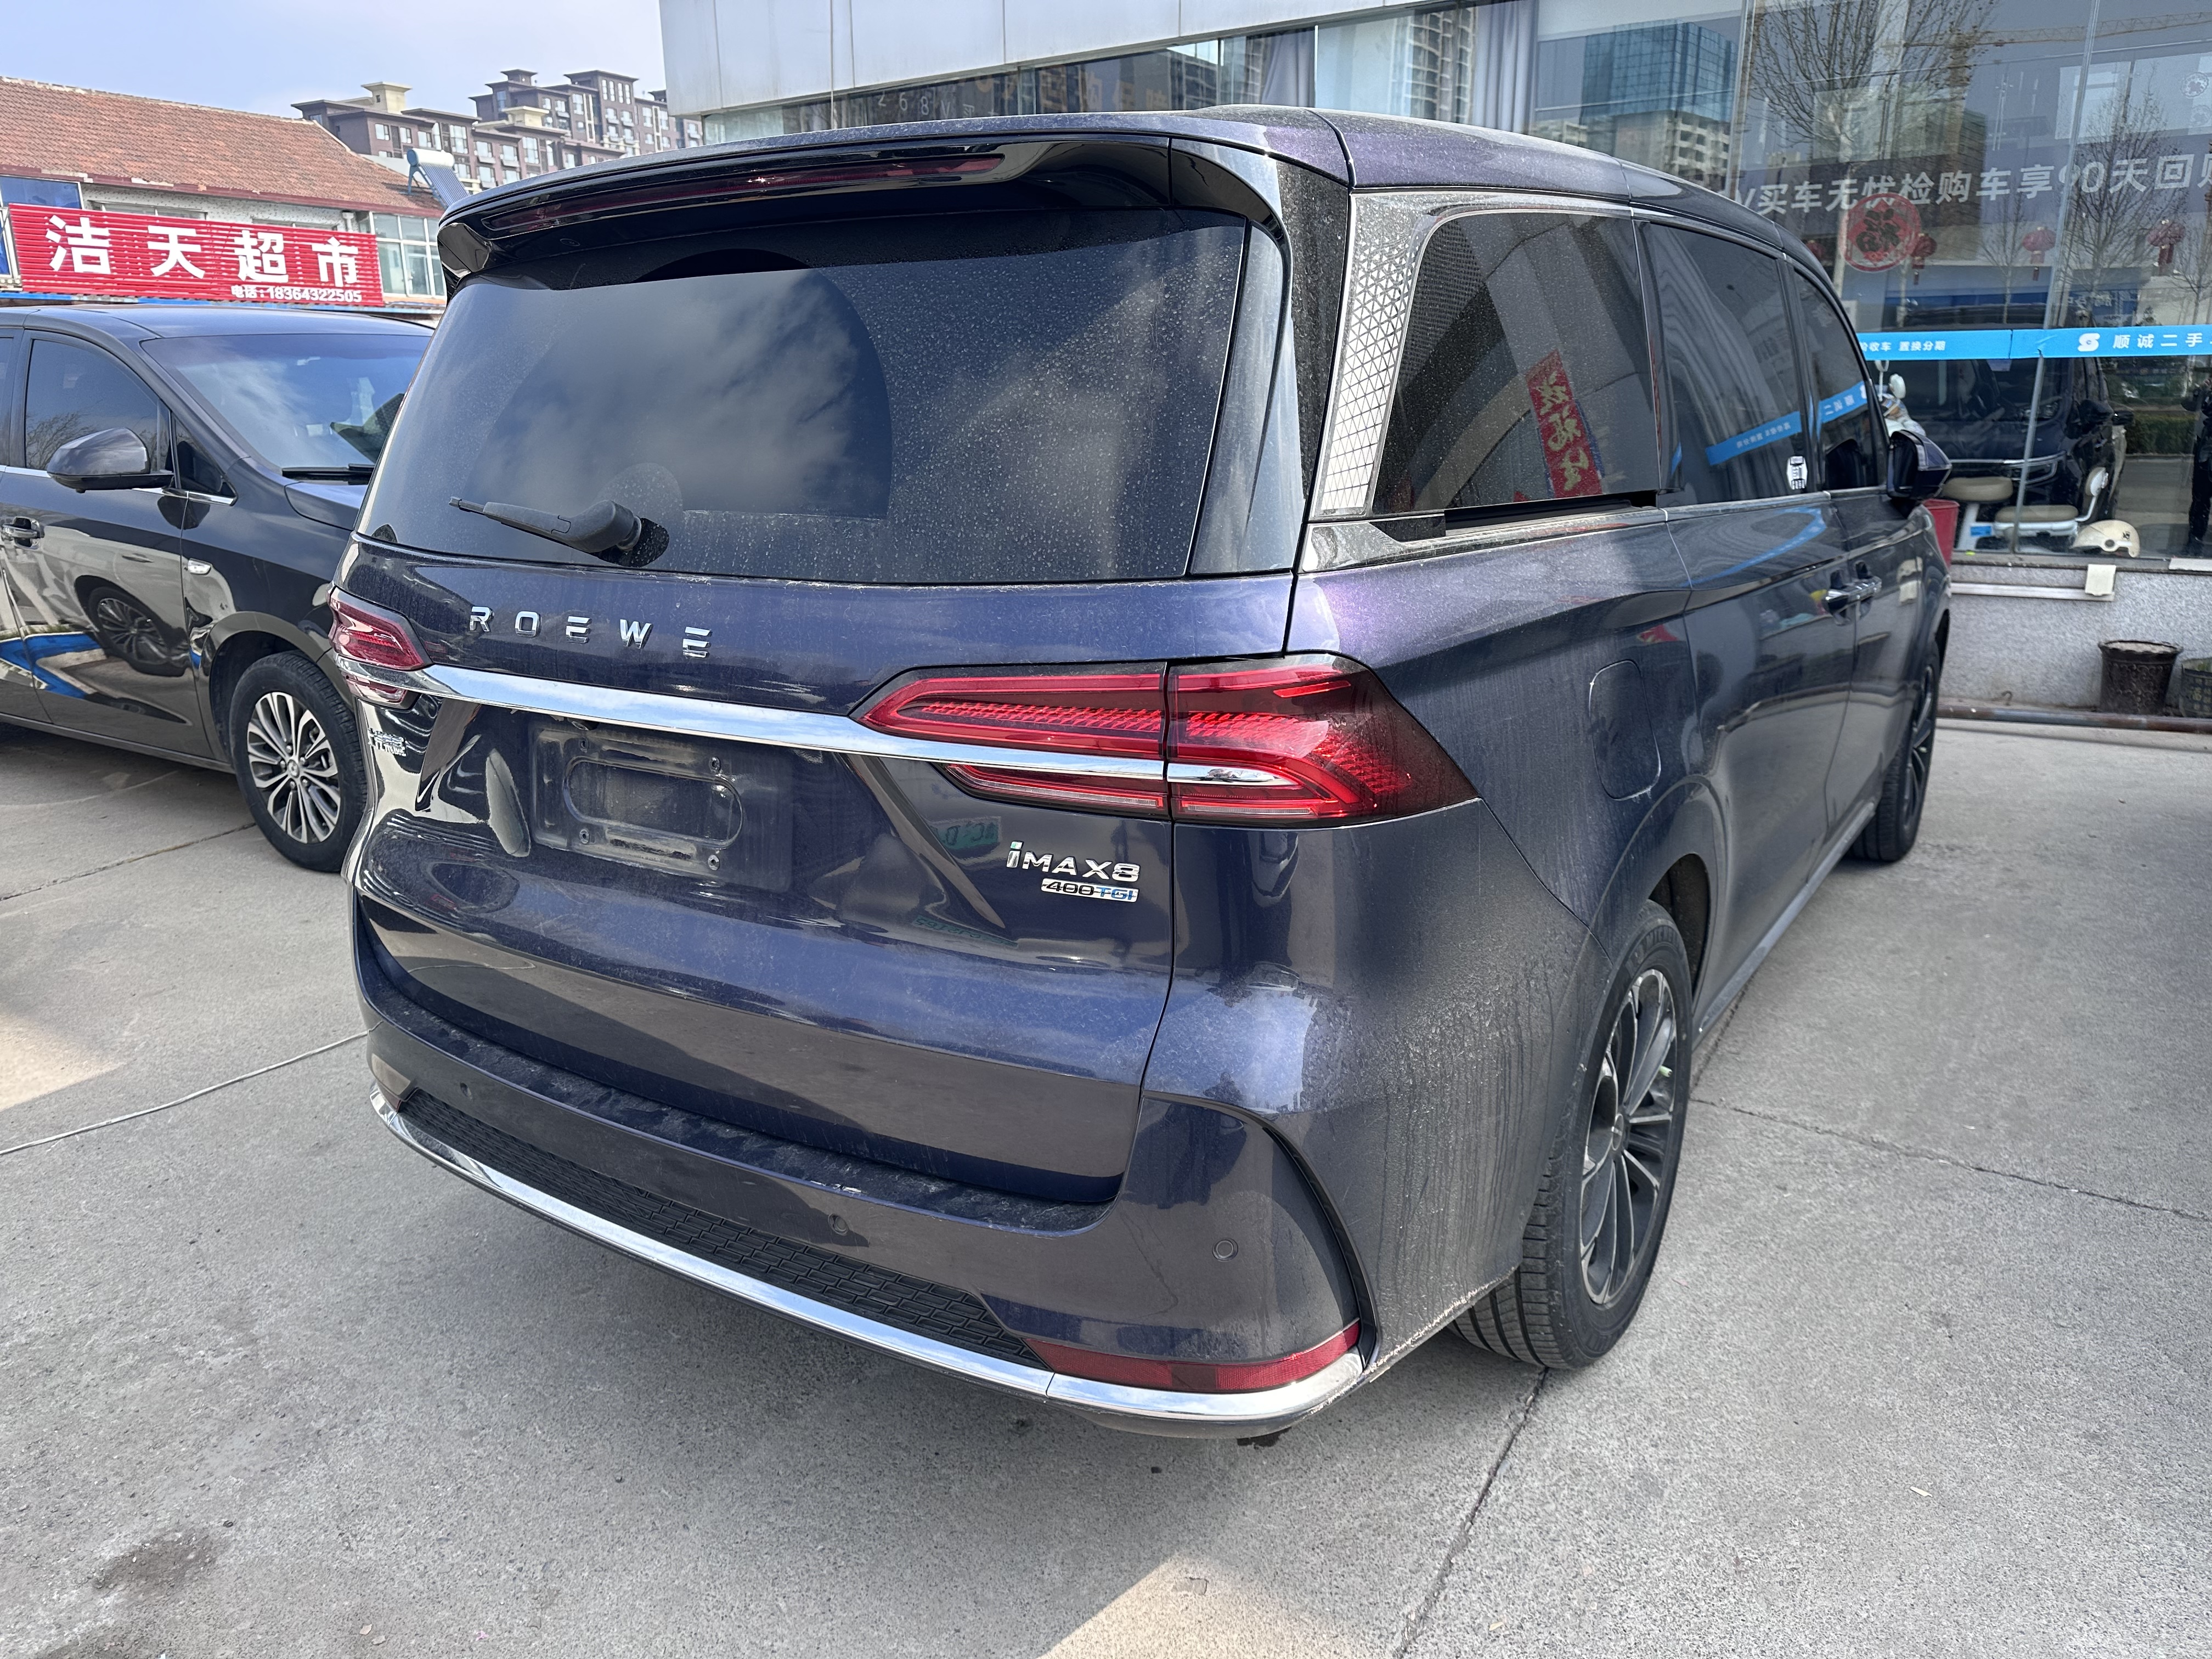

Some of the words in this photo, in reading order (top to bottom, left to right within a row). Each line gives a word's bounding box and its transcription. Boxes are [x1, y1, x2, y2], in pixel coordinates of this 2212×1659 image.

[45, 215, 359, 287] 洁天超市
[1899, 340, 1946, 352] 置换分期
[2113, 332, 2212, 349] 顺诚二手
[469, 606, 713, 659] ROEWE
[1006, 840, 1141, 882] iMAX8
